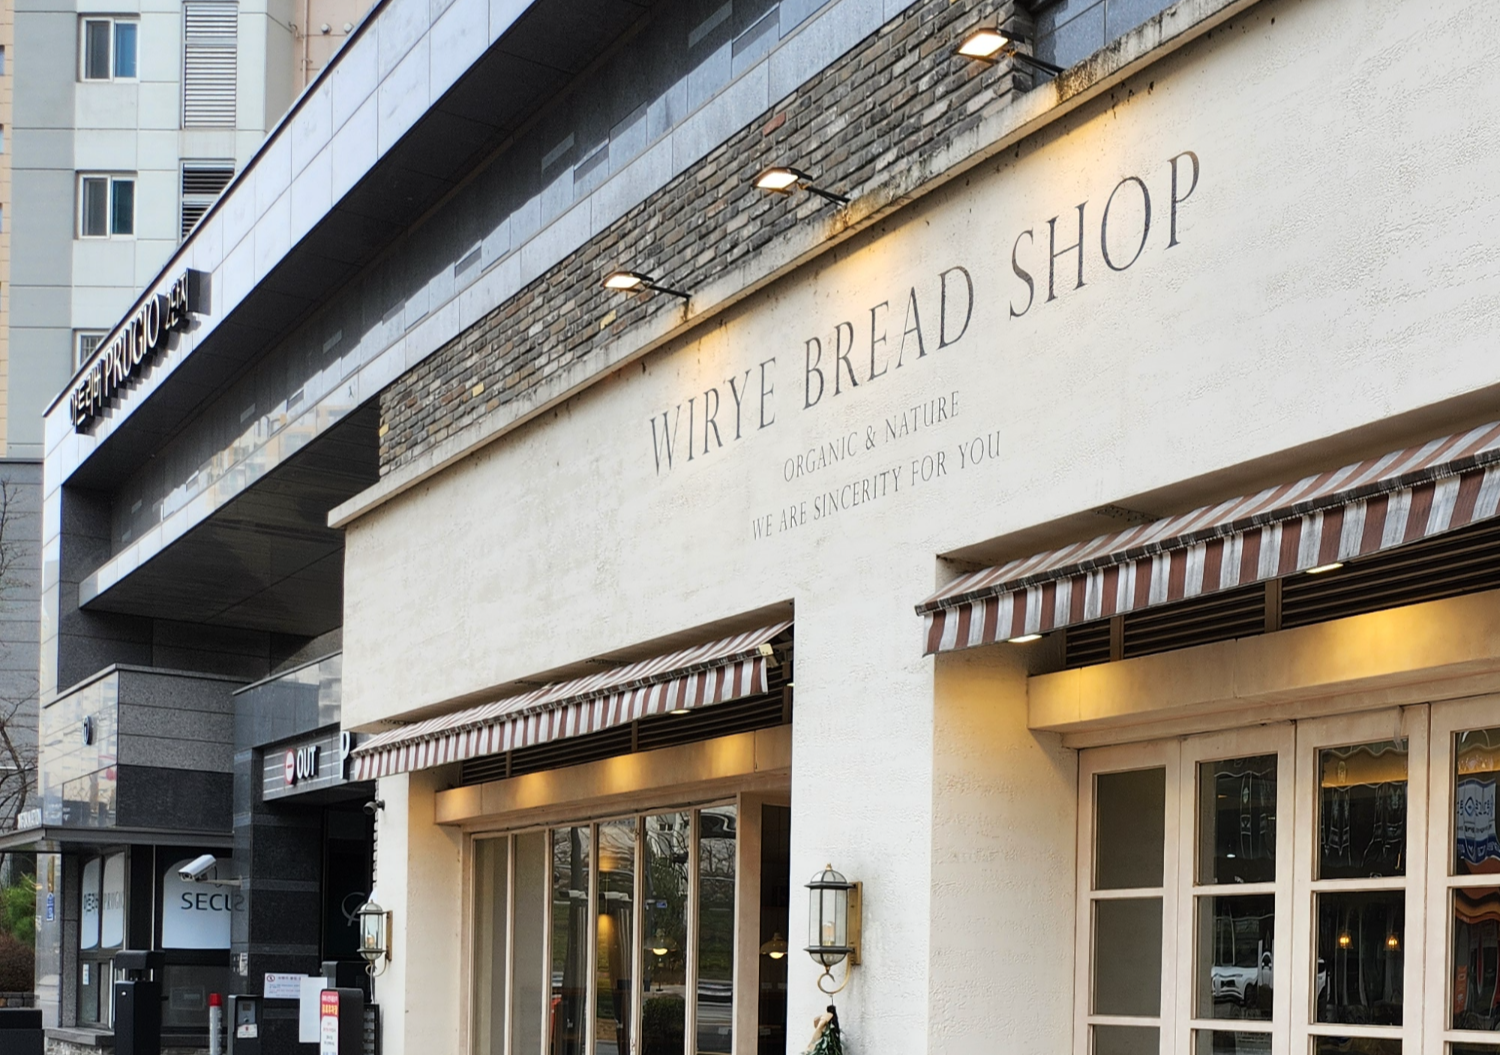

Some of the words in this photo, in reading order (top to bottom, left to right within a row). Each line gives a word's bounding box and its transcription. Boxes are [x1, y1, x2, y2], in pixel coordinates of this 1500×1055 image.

[105, 293, 159, 397] PRUGIO
[650, 356, 776, 476] WIRYE
[802, 265, 974, 411] BREAD
[1009, 150, 1200, 321] SHOP
[752, 513, 775, 541] WE
[780, 501, 808, 532] ARE
[813, 465, 902, 522] SINCERITY
[910, 450, 947, 487] FOR
[958, 430, 1002, 469] YOU
[783, 430, 857, 483] ORGANIC
[865, 426, 877, 451] &
[884, 391, 959, 442] NATURE
[296, 746, 316, 779] OUT
[339, 731, 350, 779] P
